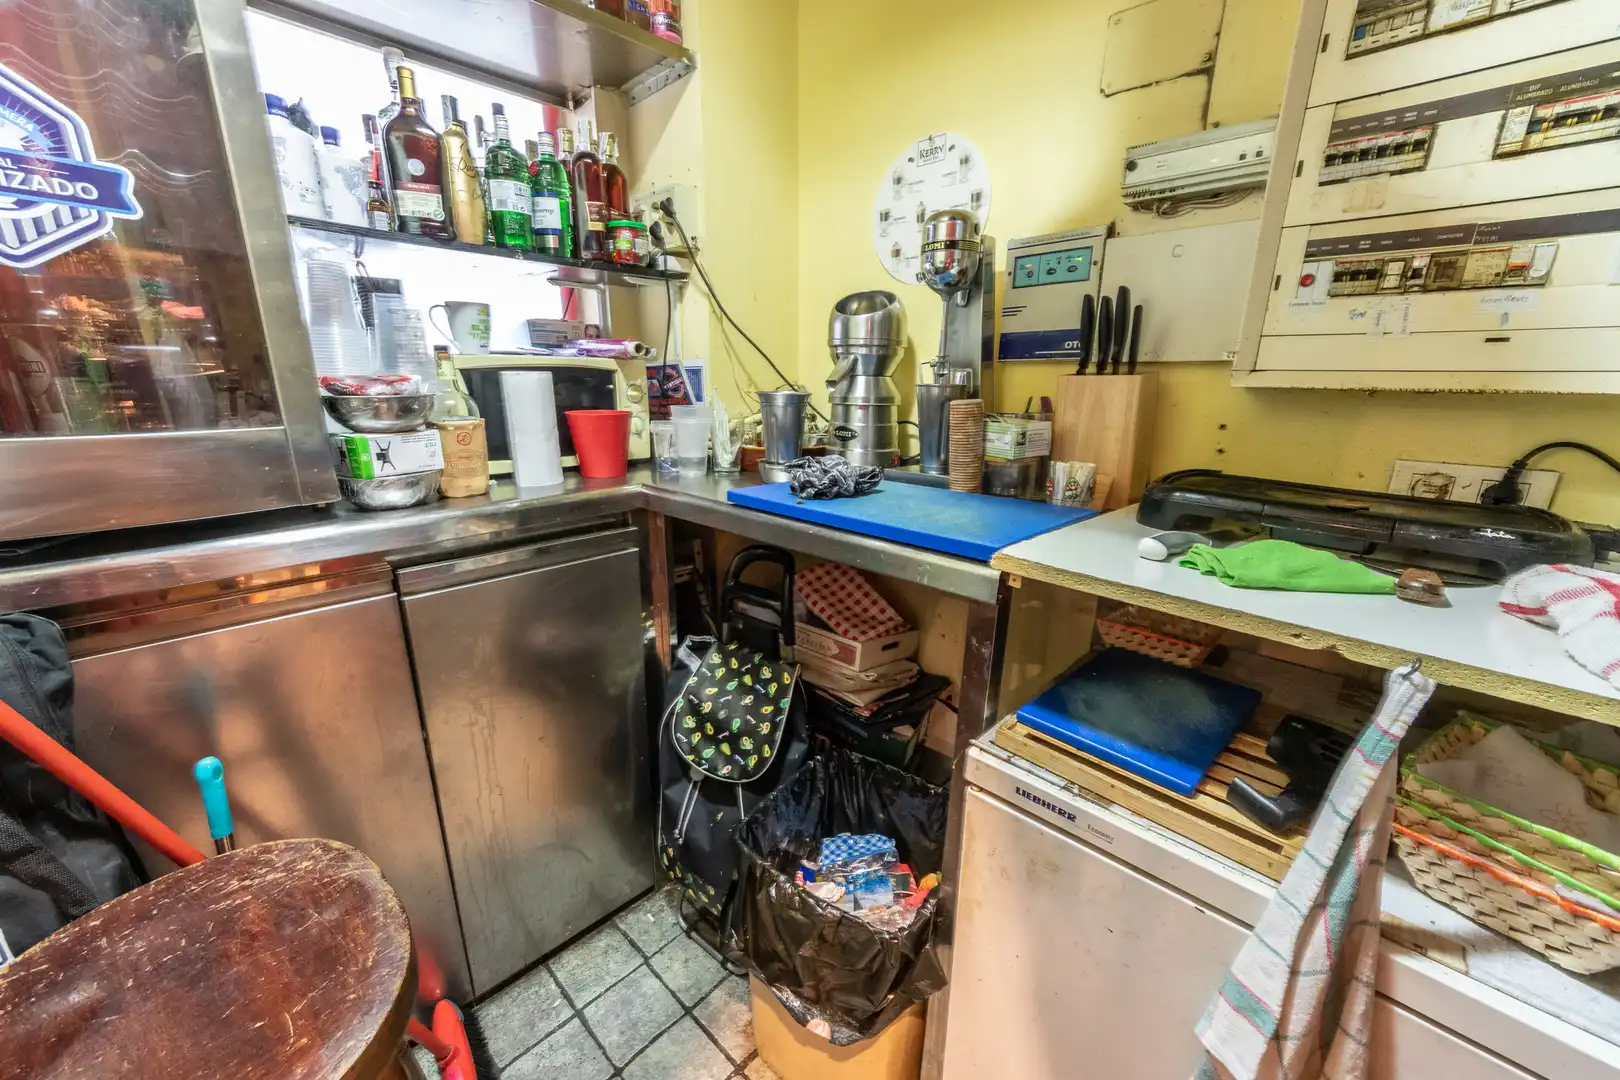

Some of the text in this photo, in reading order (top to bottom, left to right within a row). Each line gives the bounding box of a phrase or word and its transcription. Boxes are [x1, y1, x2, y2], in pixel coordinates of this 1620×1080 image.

[1560, 79, 1600, 92] ALUMBRADO
[1516, 89, 1553, 101] ALUMBRADO
[919, 144, 945, 159] KERRY
[925, 242, 945, 251] LOMI
[1015, 786, 1077, 823] LIEBHERR
[1087, 824, 1115, 842] Economy
